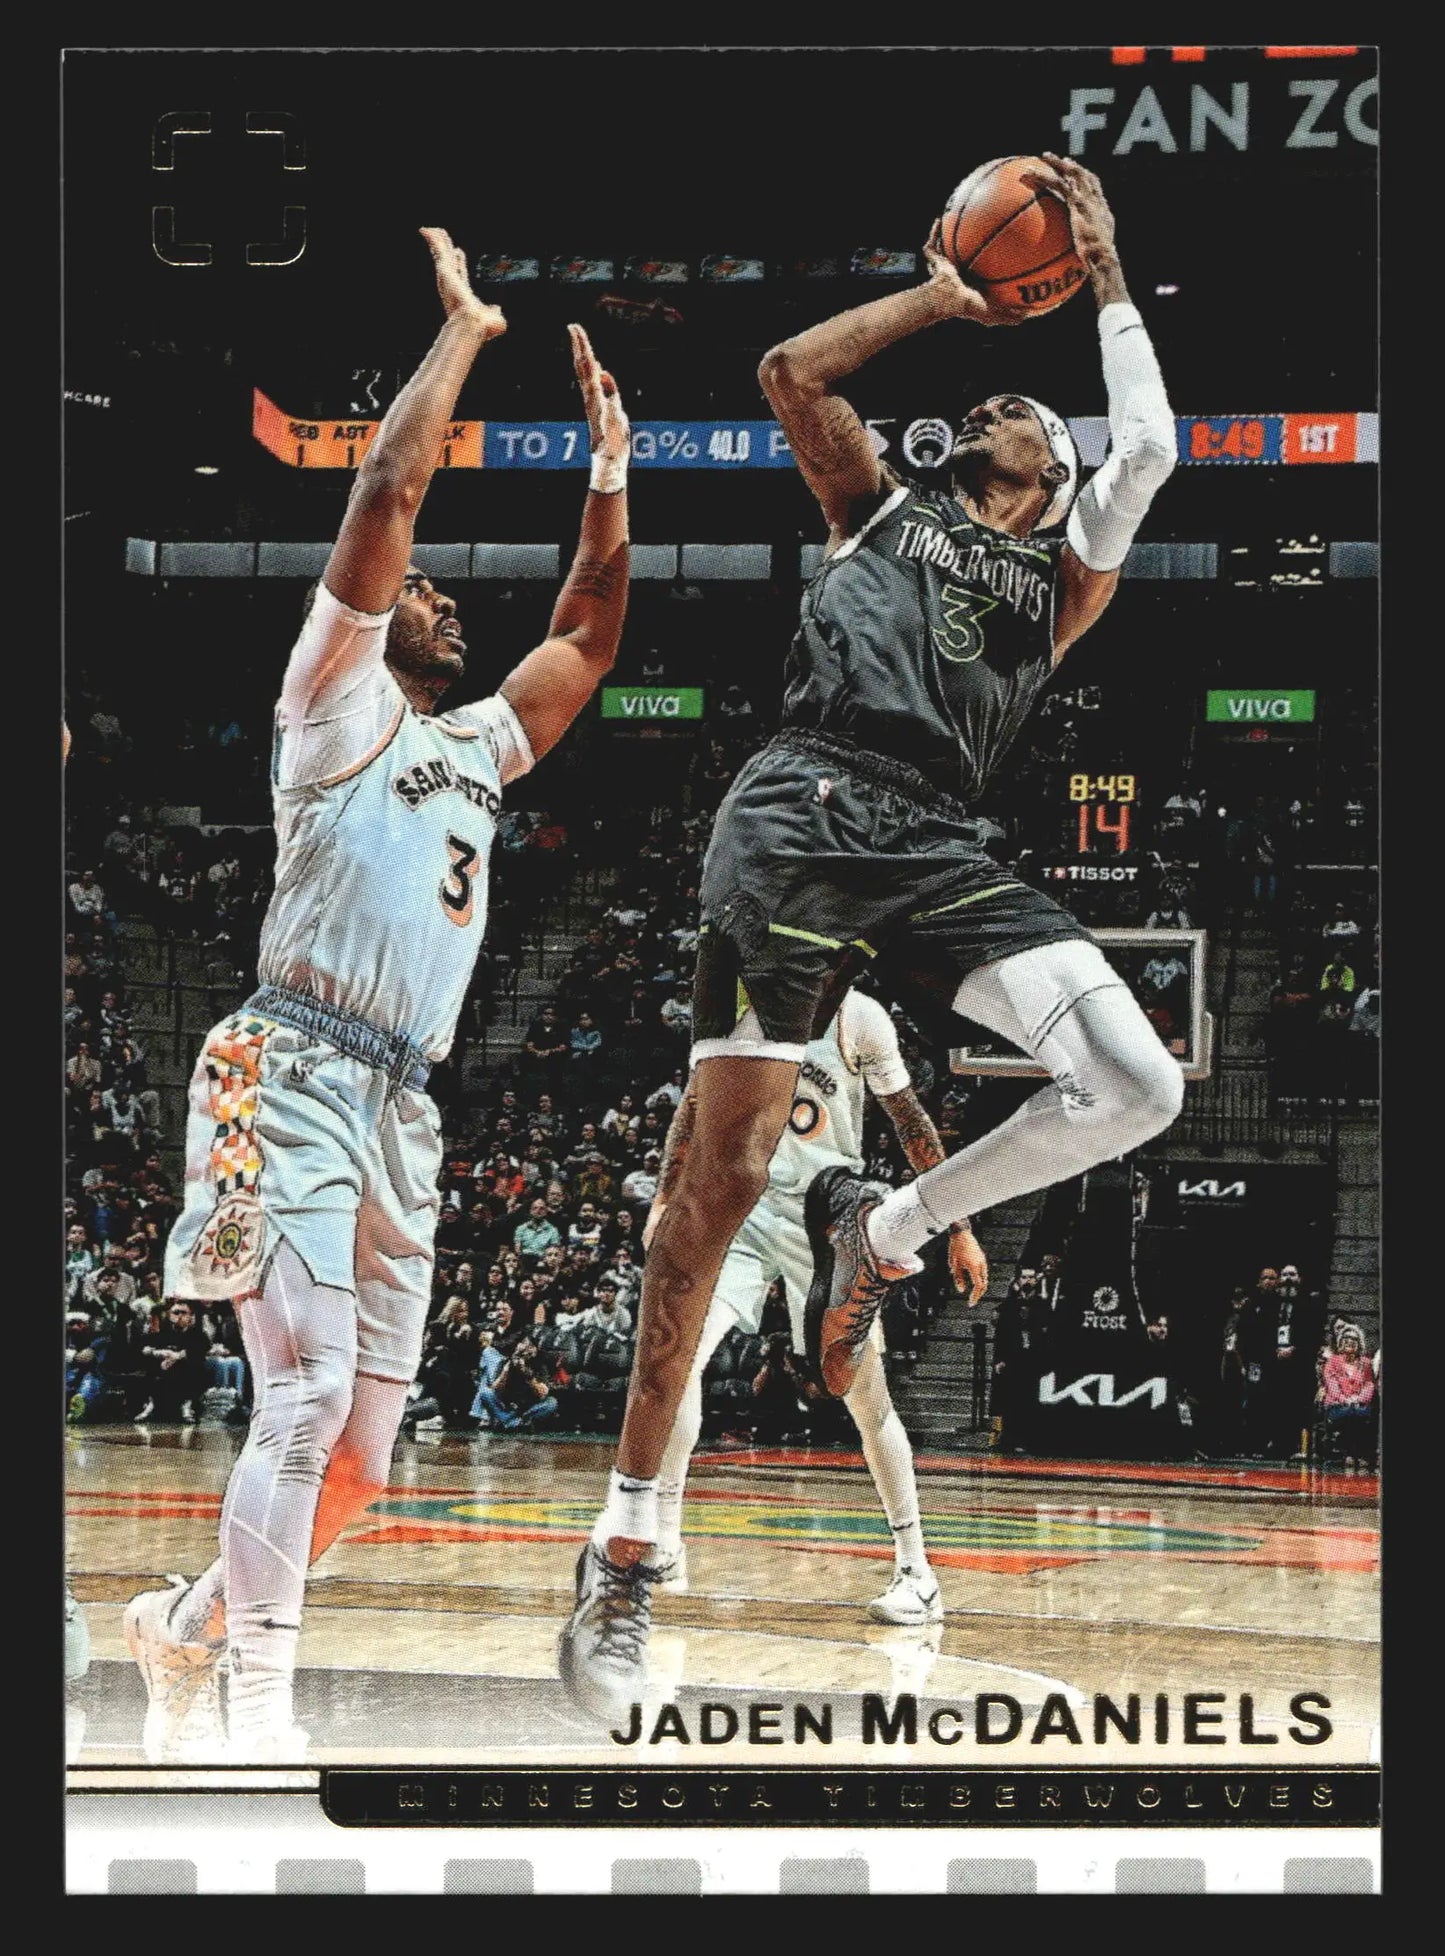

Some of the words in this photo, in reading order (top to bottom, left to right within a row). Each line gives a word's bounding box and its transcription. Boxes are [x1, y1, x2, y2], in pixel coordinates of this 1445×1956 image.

[1061, 82, 1249, 156] FAN
[333, 423, 369, 441] AST
[498, 430, 549, 460] TO
[630, 430, 699, 460] G%
[1190, 421, 1265, 459] 8:49
[1299, 424, 1340, 454] 1ST
[931, 583, 1000, 663] 3
[621, 695, 680, 717] viva
[1227, 698, 1292, 720] viva
[392, 757, 453, 808] SAN
[1069, 773, 1136, 803] 8:49
[1078, 804, 1130, 853] 14
[439, 831, 480, 922] 3
[1067, 866, 1139, 882] TISSOT
[1082, 1310, 1128, 1330] Frost
[1039, 1371, 1168, 1410] KIA
[610, 1702, 834, 1746] JADEN
[861, 1691, 1334, 1746] McDANIELS
[399, 1783, 774, 1808] MINNESOTA
[822, 1783, 1333, 1808] TIMBERWOLVES
